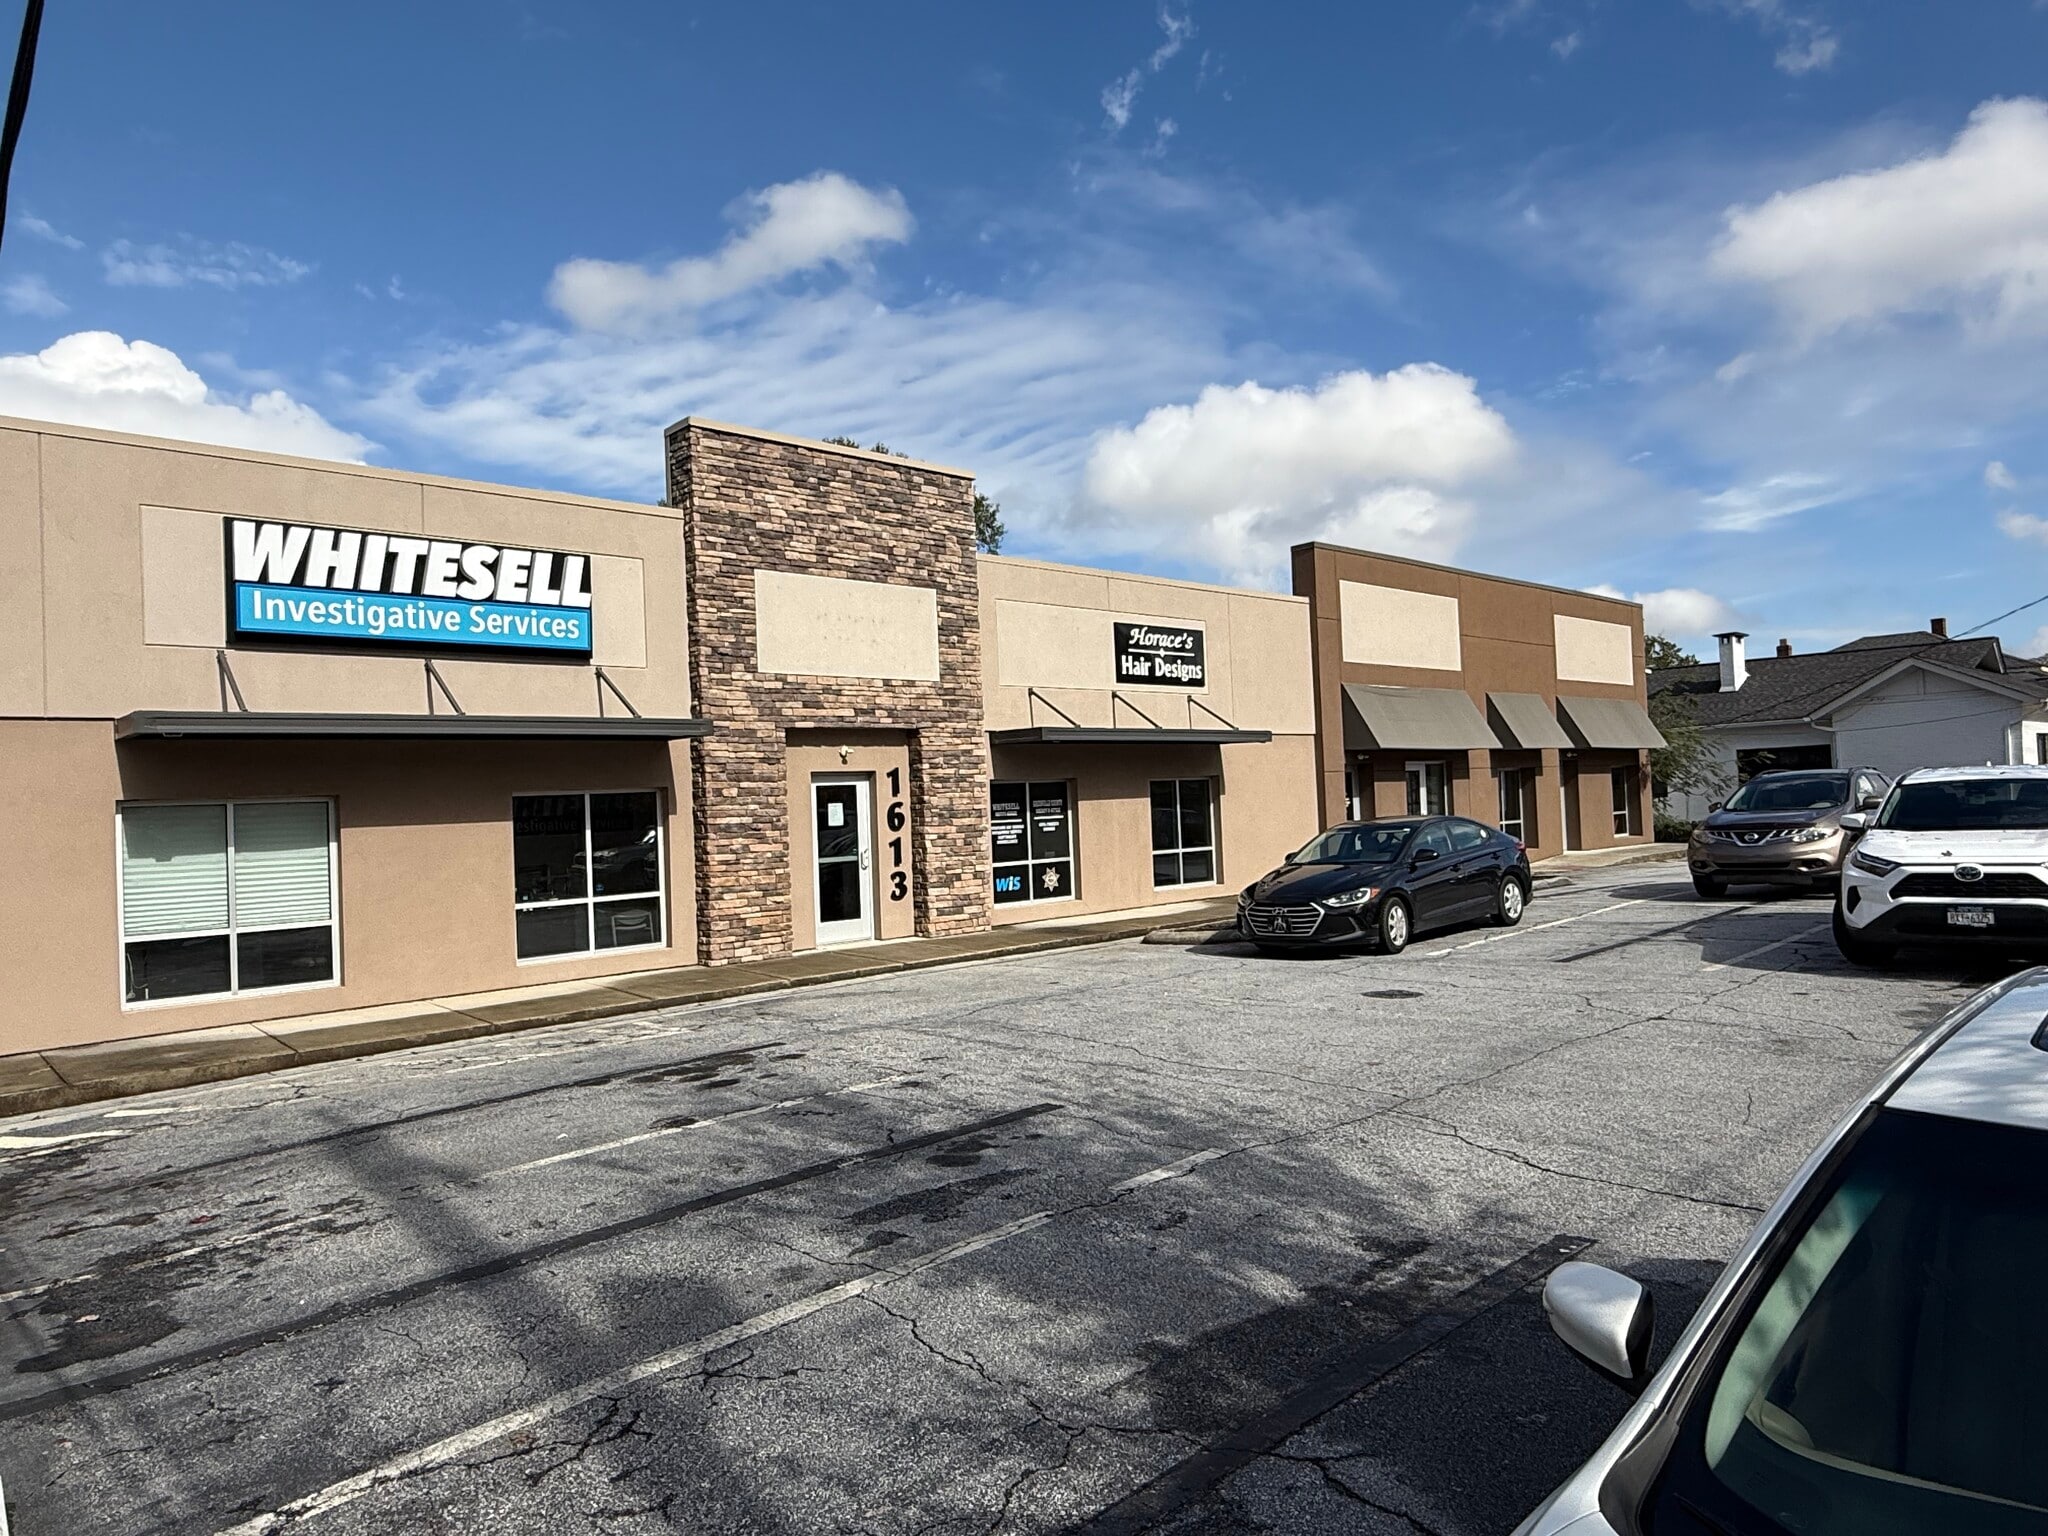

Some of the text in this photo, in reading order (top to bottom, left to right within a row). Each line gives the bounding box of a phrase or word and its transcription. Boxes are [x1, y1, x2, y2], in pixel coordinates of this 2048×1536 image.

[233, 519, 592, 608] WHITESELL
[252, 589, 580, 639] Investigative Services
[1128, 626, 1194, 649] Horace's
[1121, 654, 1202, 682] Hair Designs
[886, 767, 908, 901] 1613
